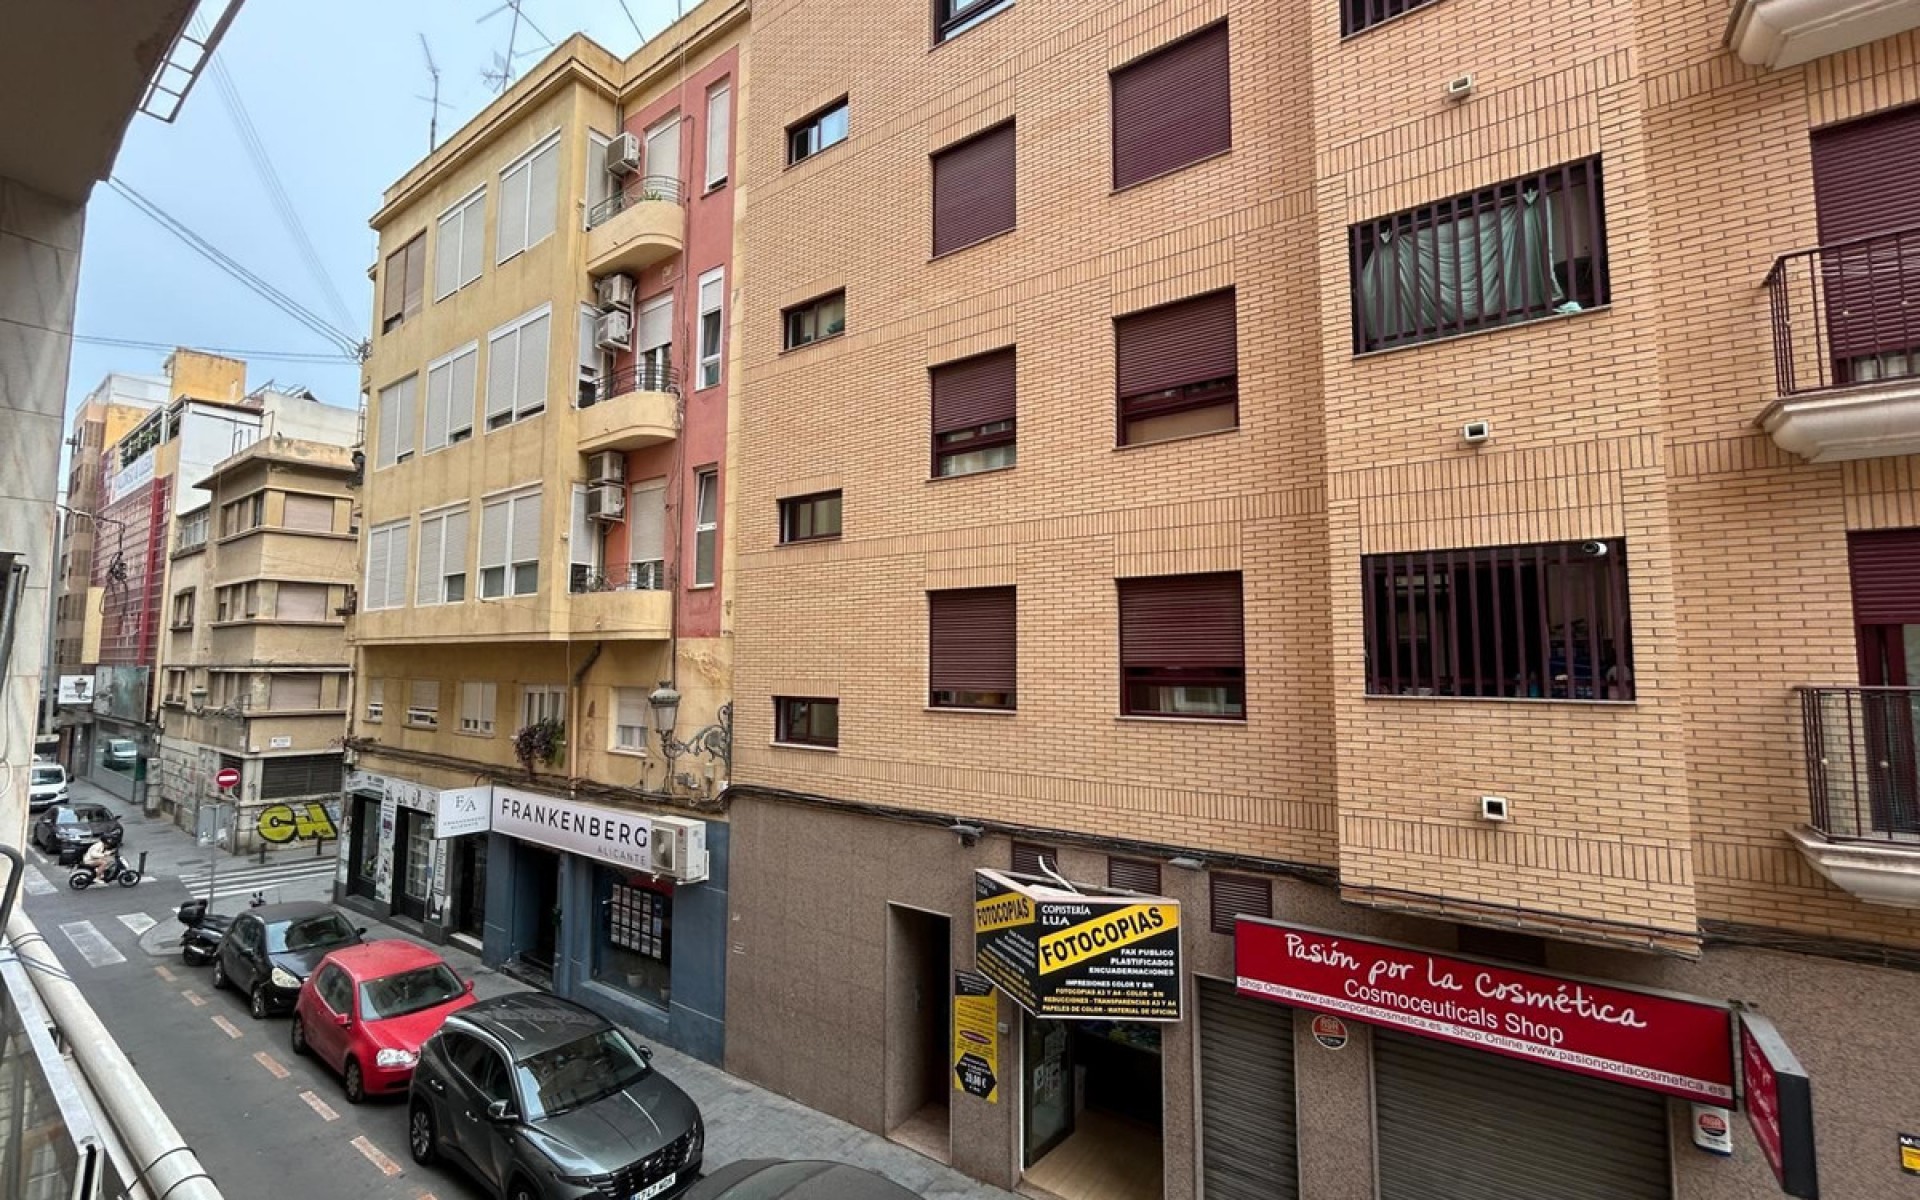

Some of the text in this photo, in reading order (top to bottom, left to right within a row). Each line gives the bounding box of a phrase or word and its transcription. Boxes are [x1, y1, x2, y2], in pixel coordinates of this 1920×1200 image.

[501, 798, 648, 848] FRANKENBERG
[597, 845, 647, 866] ALICANTE
[976, 897, 1029, 927] FOTOCOPIAS
[1042, 916, 1070, 925] LUA
[1040, 906, 1164, 966] FOTOCOPIAS
[1110, 957, 1174, 966] PLASTIFICADOS
[1121, 948, 1137, 956] FAX
[1088, 967, 1174, 976] ENCUADERNACIONES
[1284, 933, 1648, 1028] Pasión por la Cosmética
[1043, 996, 1089, 1004] REDUCCIONES
[1344, 978, 1564, 1046] Cosmoceuticals Shop
[1239, 978, 1263, 991] Shop
[1264, 983, 1293, 996] Online
[1452, 1025, 1482, 1041] Shop
[1484, 1032, 1525, 1051] Online
[1526, 1045, 1727, 1097] www.pasionporlacosmetica.es
